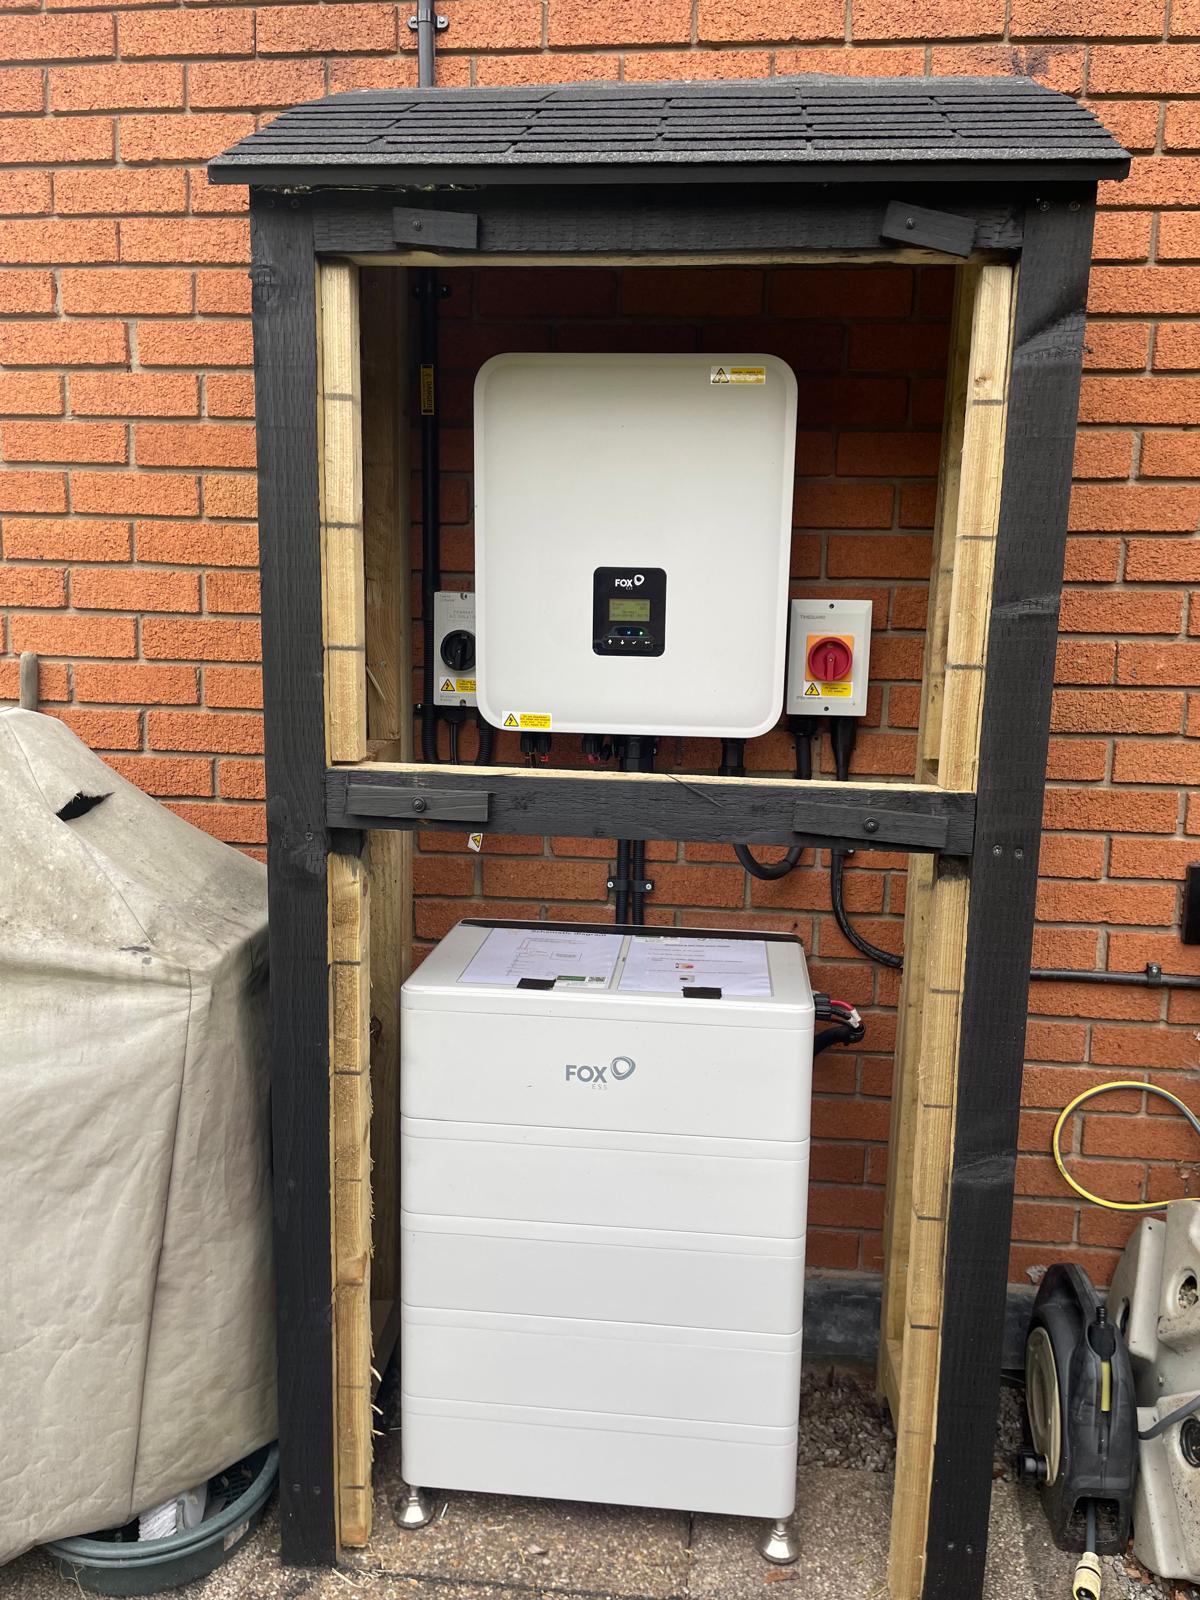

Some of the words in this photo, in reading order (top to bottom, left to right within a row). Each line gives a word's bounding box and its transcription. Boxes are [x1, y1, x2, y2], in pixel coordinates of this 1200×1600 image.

[615, 579, 633, 587] FOX
[565, 1064, 608, 1083] FOX
[591, 1083, 609, 1091] ESS
